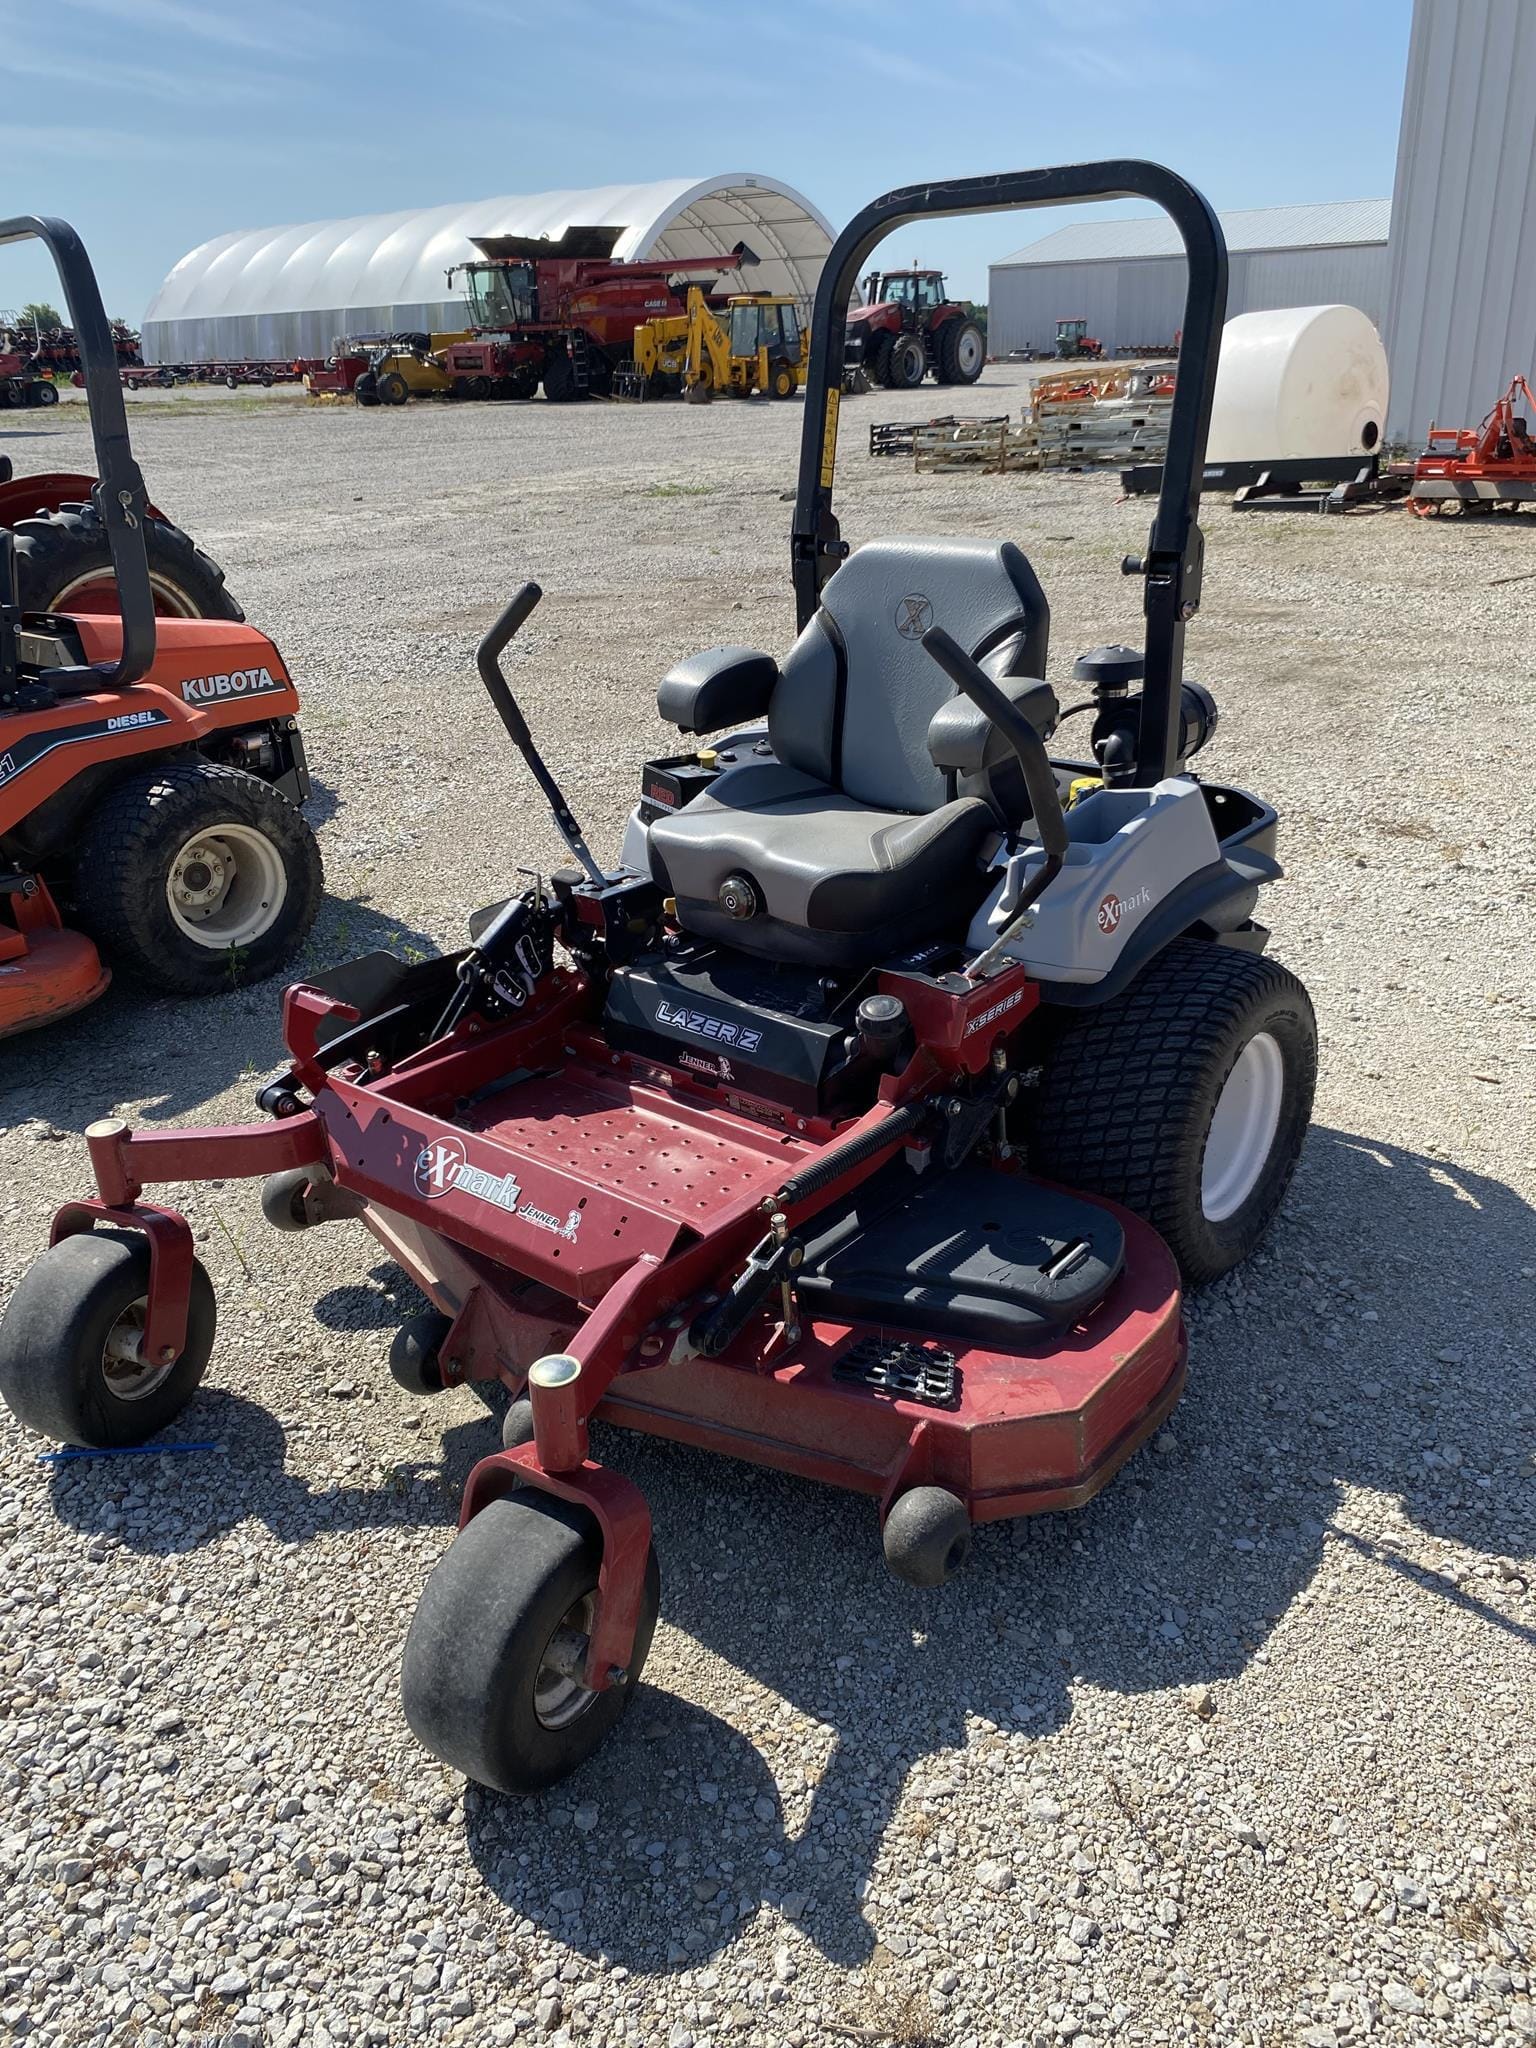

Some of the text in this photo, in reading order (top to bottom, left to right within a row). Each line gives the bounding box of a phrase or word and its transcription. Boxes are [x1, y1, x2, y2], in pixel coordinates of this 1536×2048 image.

[644, 299, 661, 308] CASE
[662, 360, 678, 369] JCB
[182, 667, 275, 701] KUBOTA
[107, 711, 156, 730] DIESEL
[650, 783, 675, 806] RED
[1097, 886, 1151, 930] eXmark
[656, 1001, 762, 1052] LAZER Z
[965, 988, 1024, 1037] X-SERIES
[417, 1144, 518, 1209] eXmark
[519, 1202, 560, 1227] JENNER
